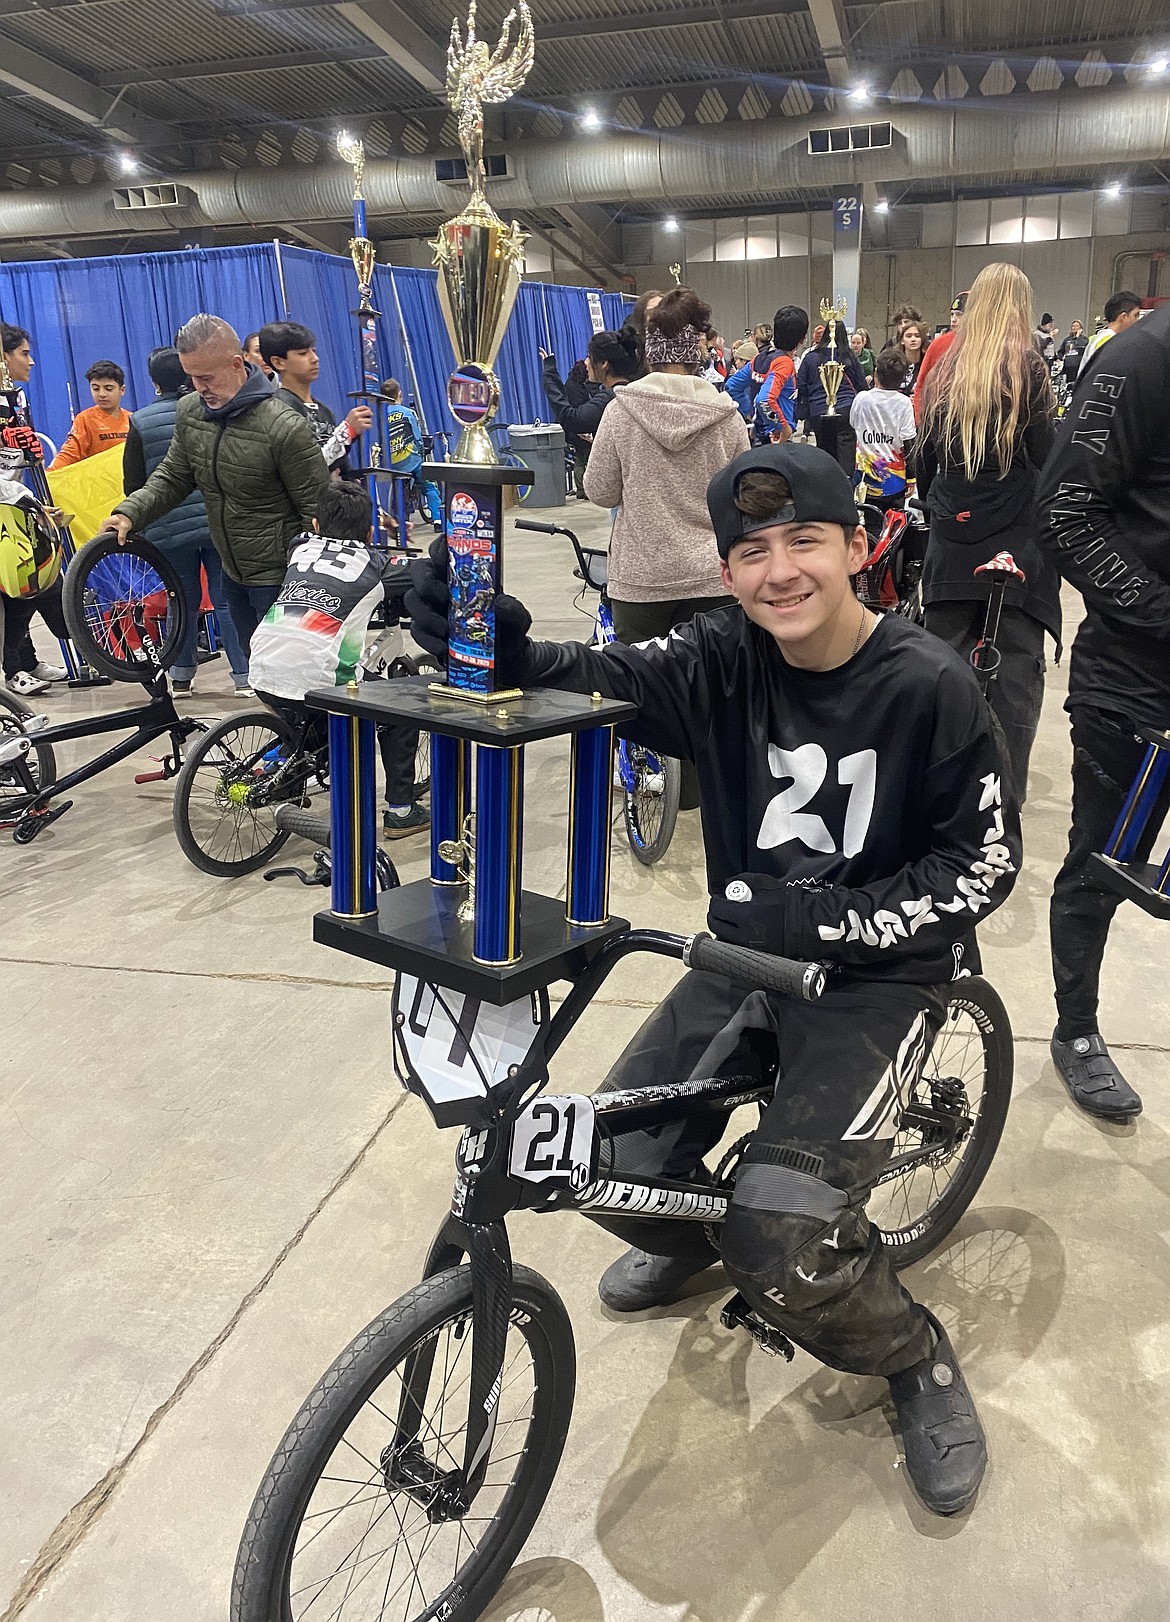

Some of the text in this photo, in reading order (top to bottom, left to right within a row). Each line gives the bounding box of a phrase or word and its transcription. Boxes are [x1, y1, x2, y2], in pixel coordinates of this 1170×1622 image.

[837, 197, 857, 211] 22
[842, 212, 852, 225] S
[1071, 373, 1126, 455] FLY
[286, 538, 370, 582] 43
[757, 742, 877, 859] 21
[947, 998, 995, 1034] alienatio
[724, 1092, 758, 1106] ENVY
[524, 1102, 576, 1171] 21
[575, 1178, 728, 1219] UPERCROSS
[880, 1228, 919, 1247] nation
